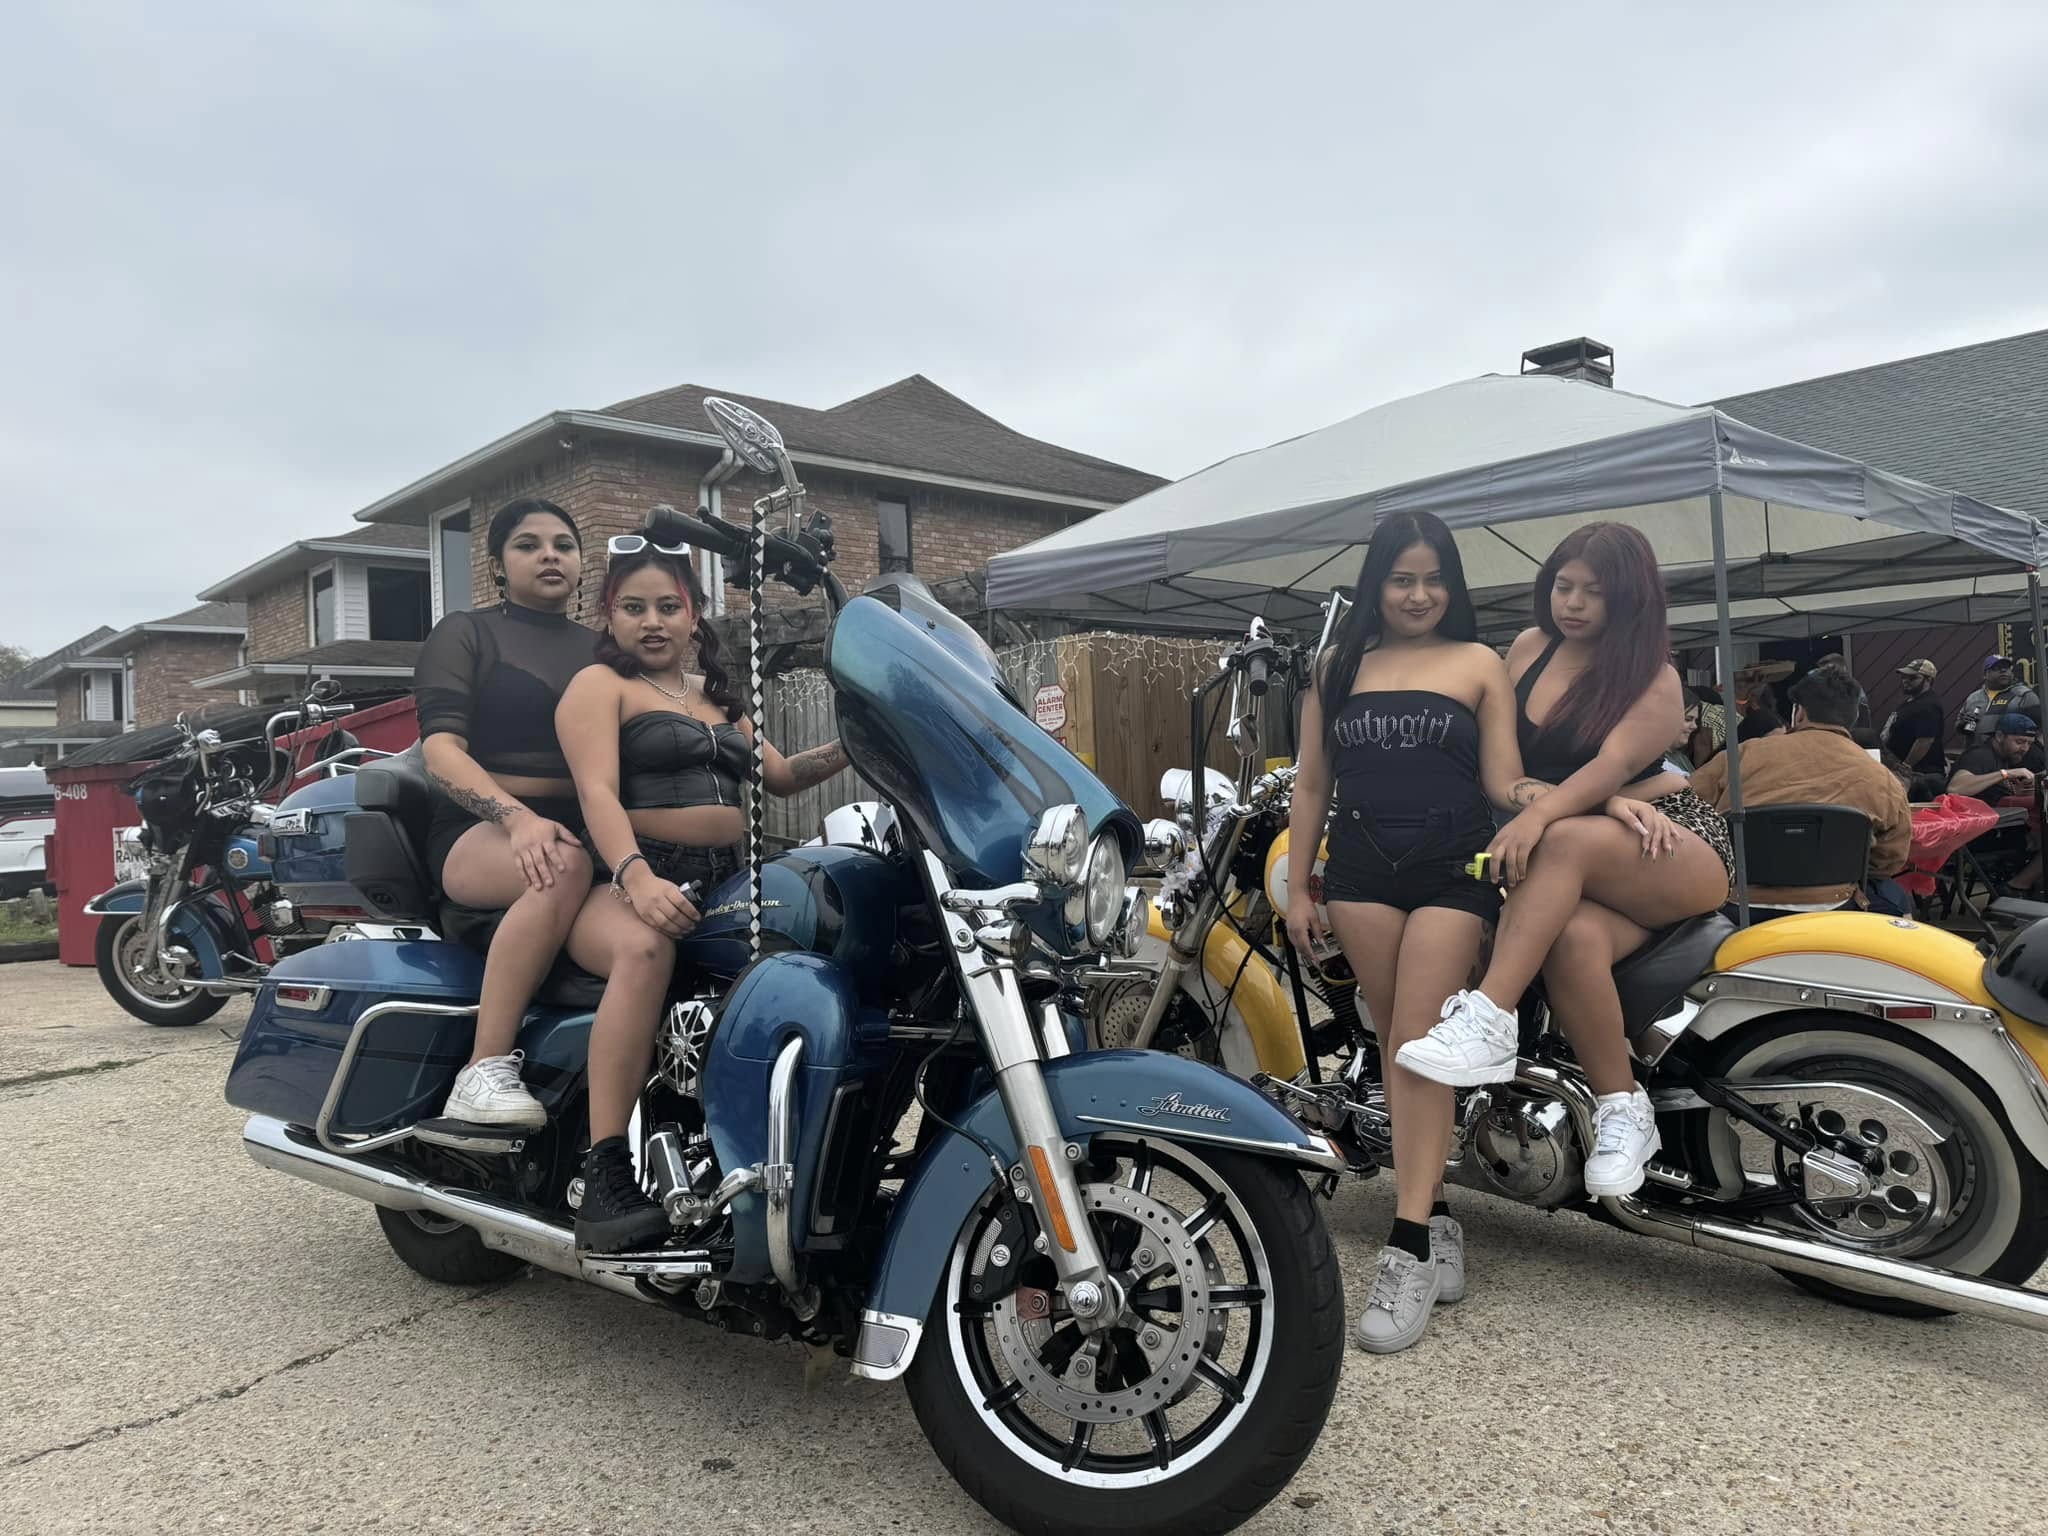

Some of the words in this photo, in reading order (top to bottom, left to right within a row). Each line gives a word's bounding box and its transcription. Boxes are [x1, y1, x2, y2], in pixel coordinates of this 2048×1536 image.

[1038, 696, 1063, 706] ALARM
[1038, 703, 1063, 714] CENTER
[1136, 1092, 1231, 1122] Limited
